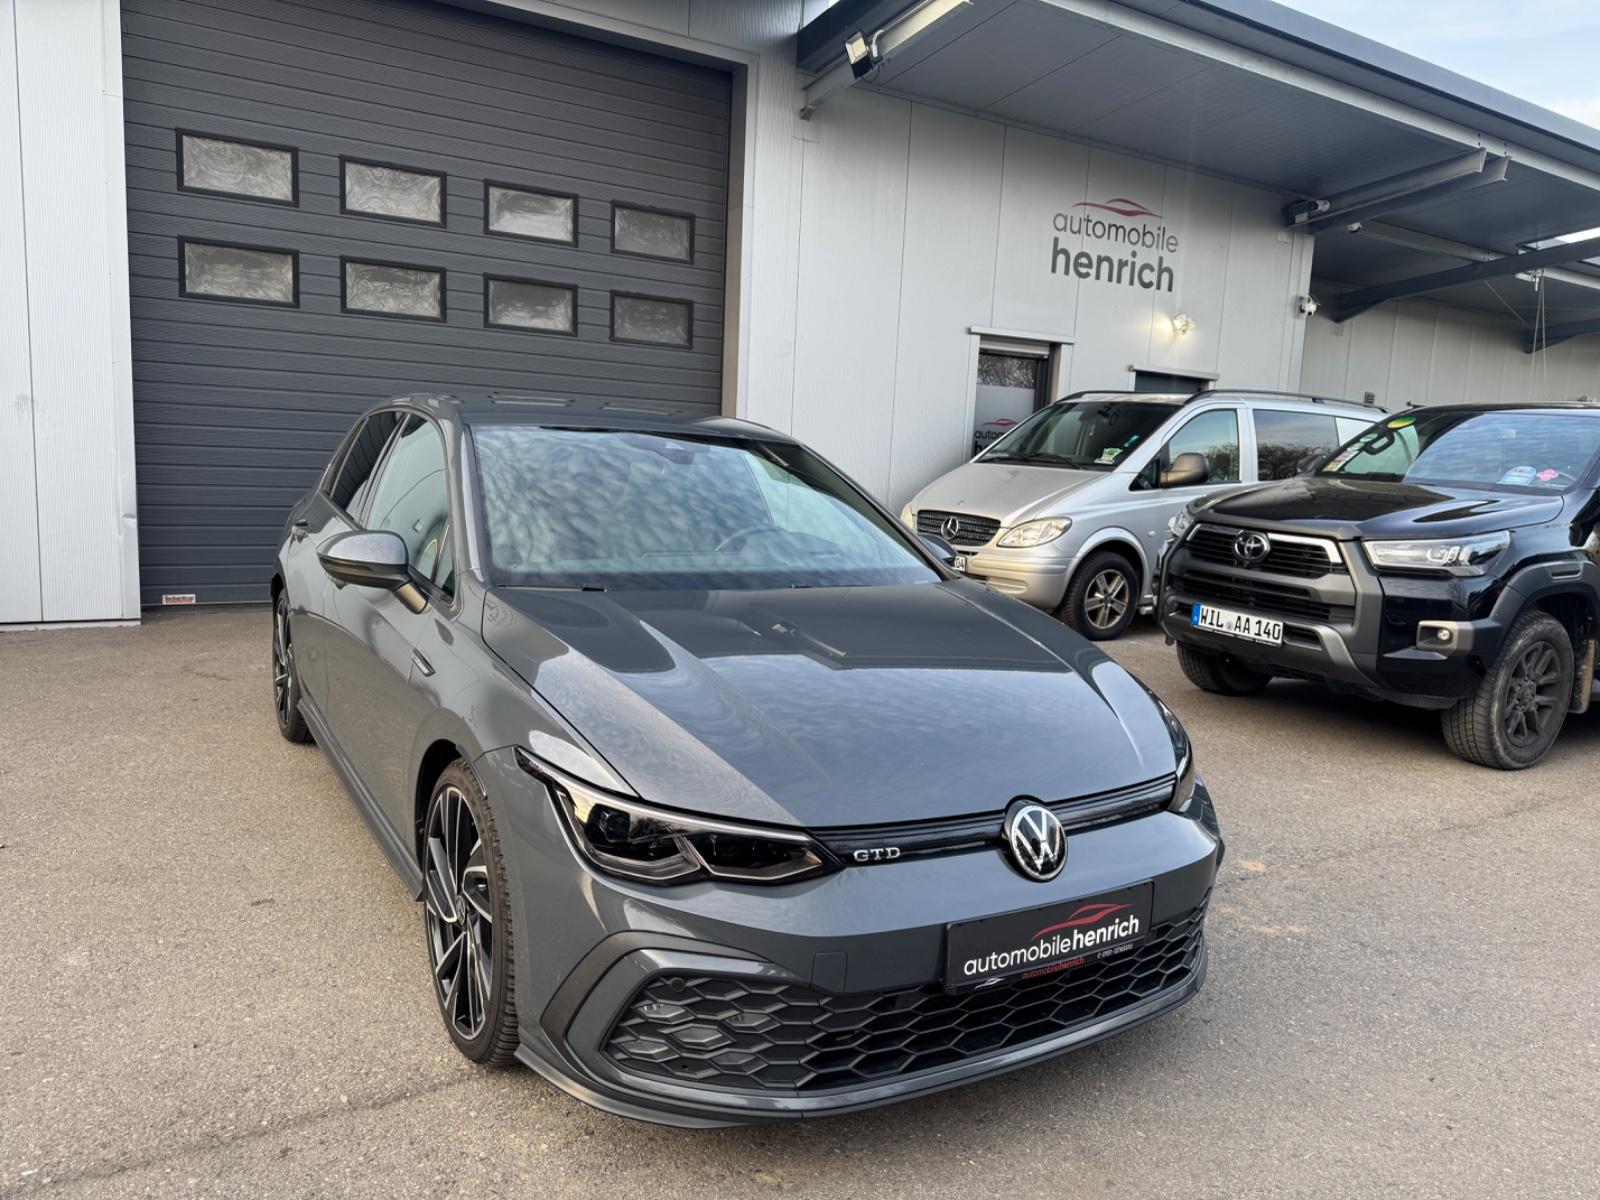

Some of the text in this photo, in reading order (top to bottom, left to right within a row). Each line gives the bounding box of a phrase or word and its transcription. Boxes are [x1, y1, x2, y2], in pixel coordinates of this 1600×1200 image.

[1052, 212, 1178, 253] automobile
[1050, 236, 1174, 292] henrich
[1234, 615, 1251, 635] AA
[1254, 620, 1281, 640] 140
[853, 847, 901, 862] GTD
